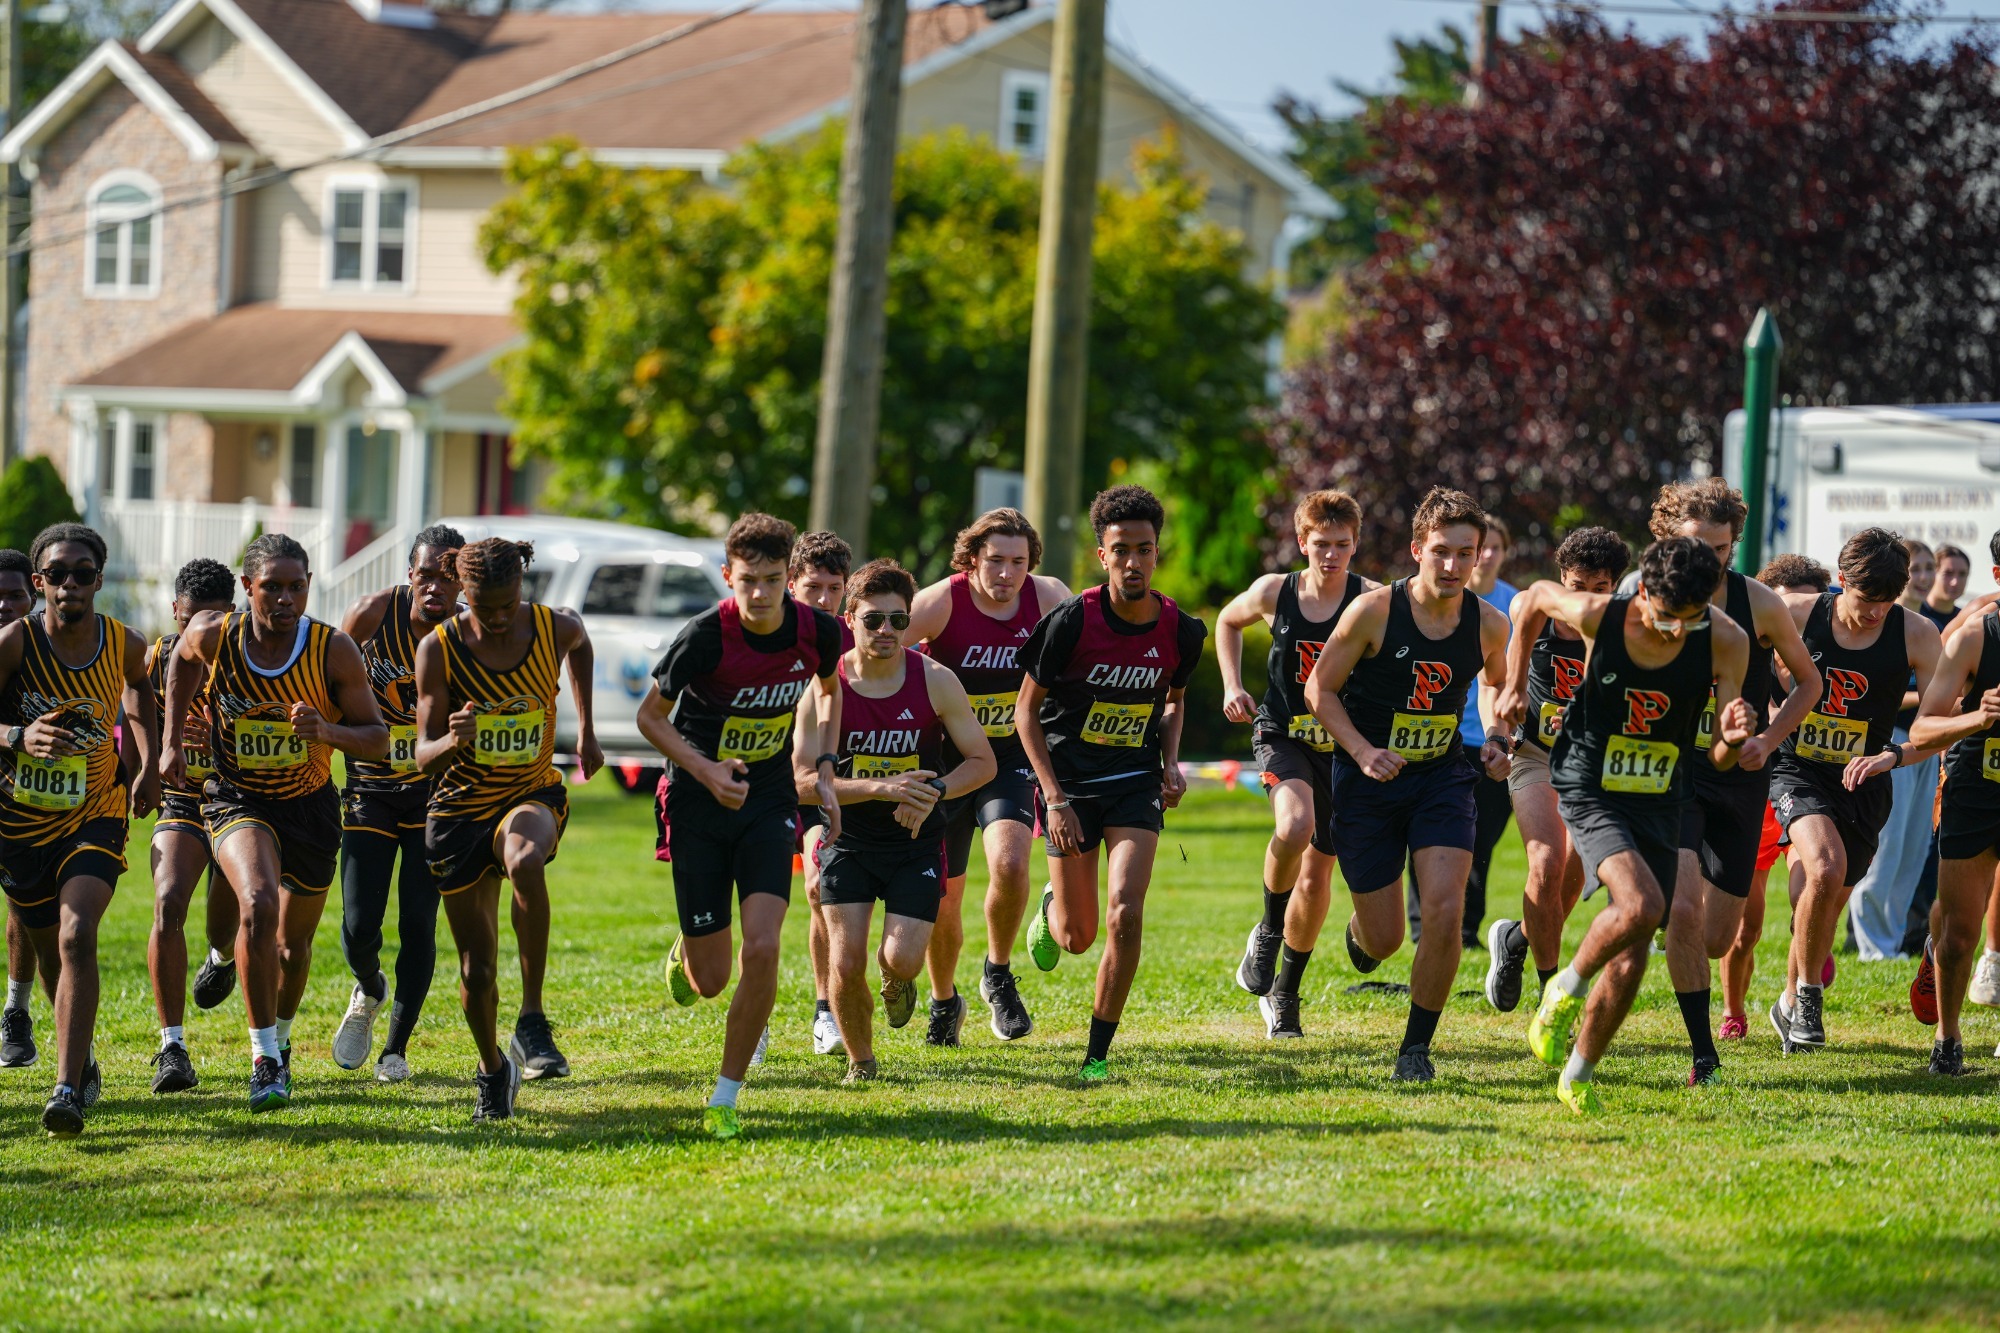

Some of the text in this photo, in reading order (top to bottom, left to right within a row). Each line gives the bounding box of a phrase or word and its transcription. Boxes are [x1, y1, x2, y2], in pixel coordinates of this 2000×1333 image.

[1086, 664, 1162, 689] CAIRN
[1407, 660, 1453, 711] P
[731, 678, 810, 709] CAIRN
[1821, 666, 1869, 717] P
[1088, 712, 1147, 736] 8025
[1623, 687, 1671, 735] P
[240, 733, 303, 756] 8078
[480, 724, 541, 752] 8094
[725, 727, 785, 751] 8024
[847, 729, 920, 754] CAIRN
[1294, 728, 1334, 745] 811
[1394, 727, 1452, 750] 8112
[1803, 723, 1863, 752] 8107
[395, 739, 417, 761] 80
[1609, 750, 1670, 778] 8114
[20, 764, 80, 795] 8081
